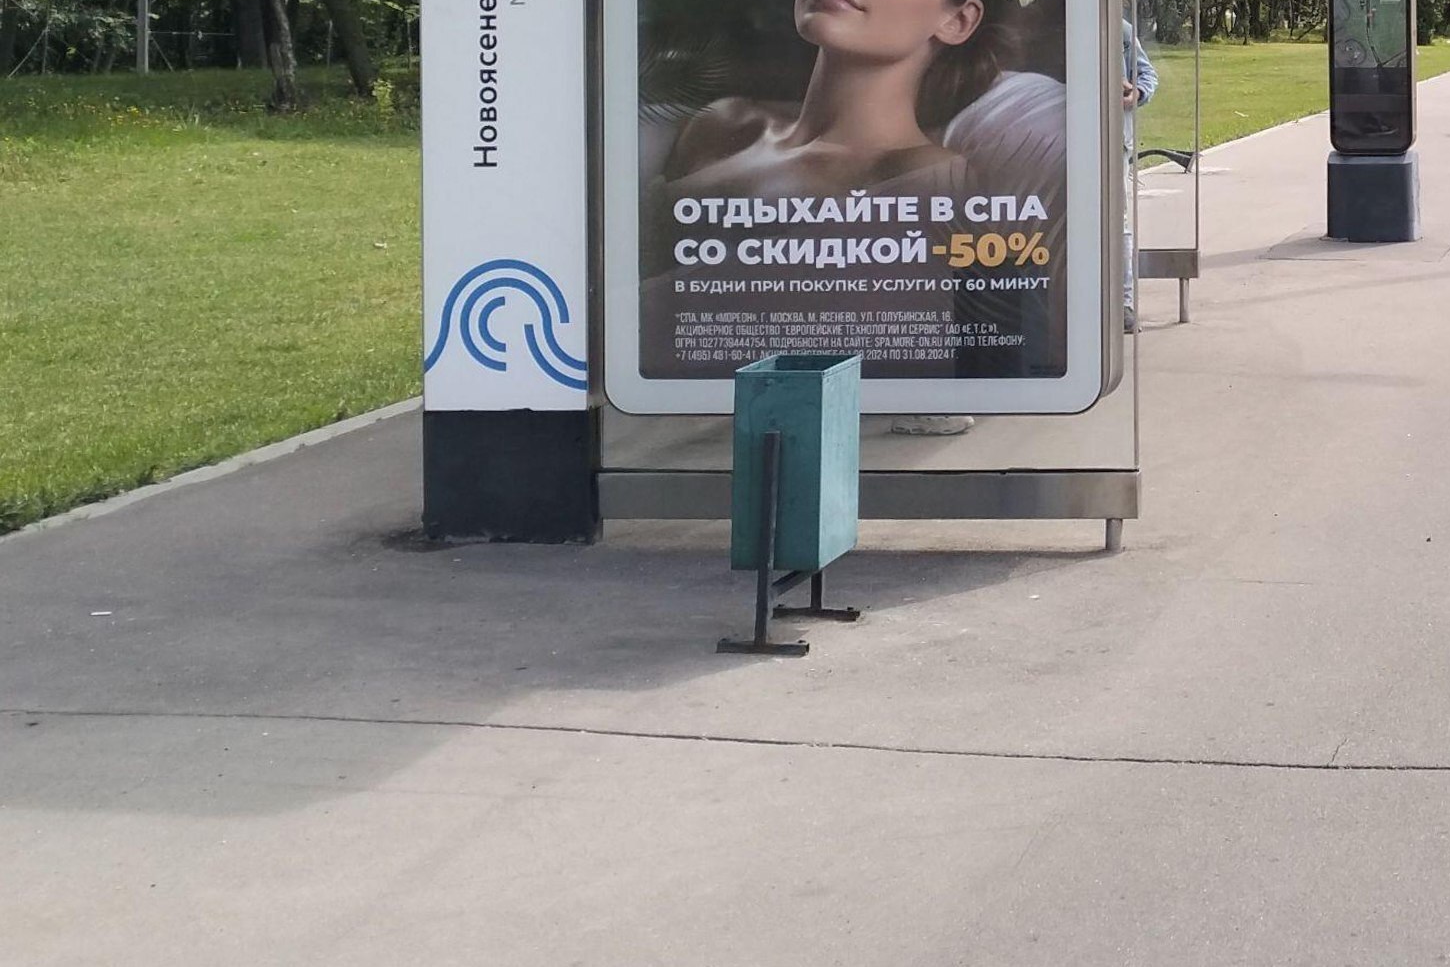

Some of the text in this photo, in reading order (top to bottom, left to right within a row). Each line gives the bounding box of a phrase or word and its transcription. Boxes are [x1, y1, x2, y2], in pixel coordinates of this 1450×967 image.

[673, 190, 1048, 228] ОТДЫХАЙТЕ В СПА
[674, 231, 1049, 269] СО СКИДКОЙ -50%
[675, 277, 1050, 294] В БУДНИ ПРИ ПОКУПКЕ УСЛУГИ ОТ 60 МИНУТ
[675, 325, 734, 336] АКЦИОНЕРНОЕ
[735, 325, 781, 336] ОБЩЕСТВО
[675, 337, 696, 348] ОГРН
[769, 337, 828, 349] ПОДРОБНОСТИ
[944, 336, 962, 347] ИЛИ
[964, 336, 975, 347] ПО
[889, 349, 900, 360] ПО
